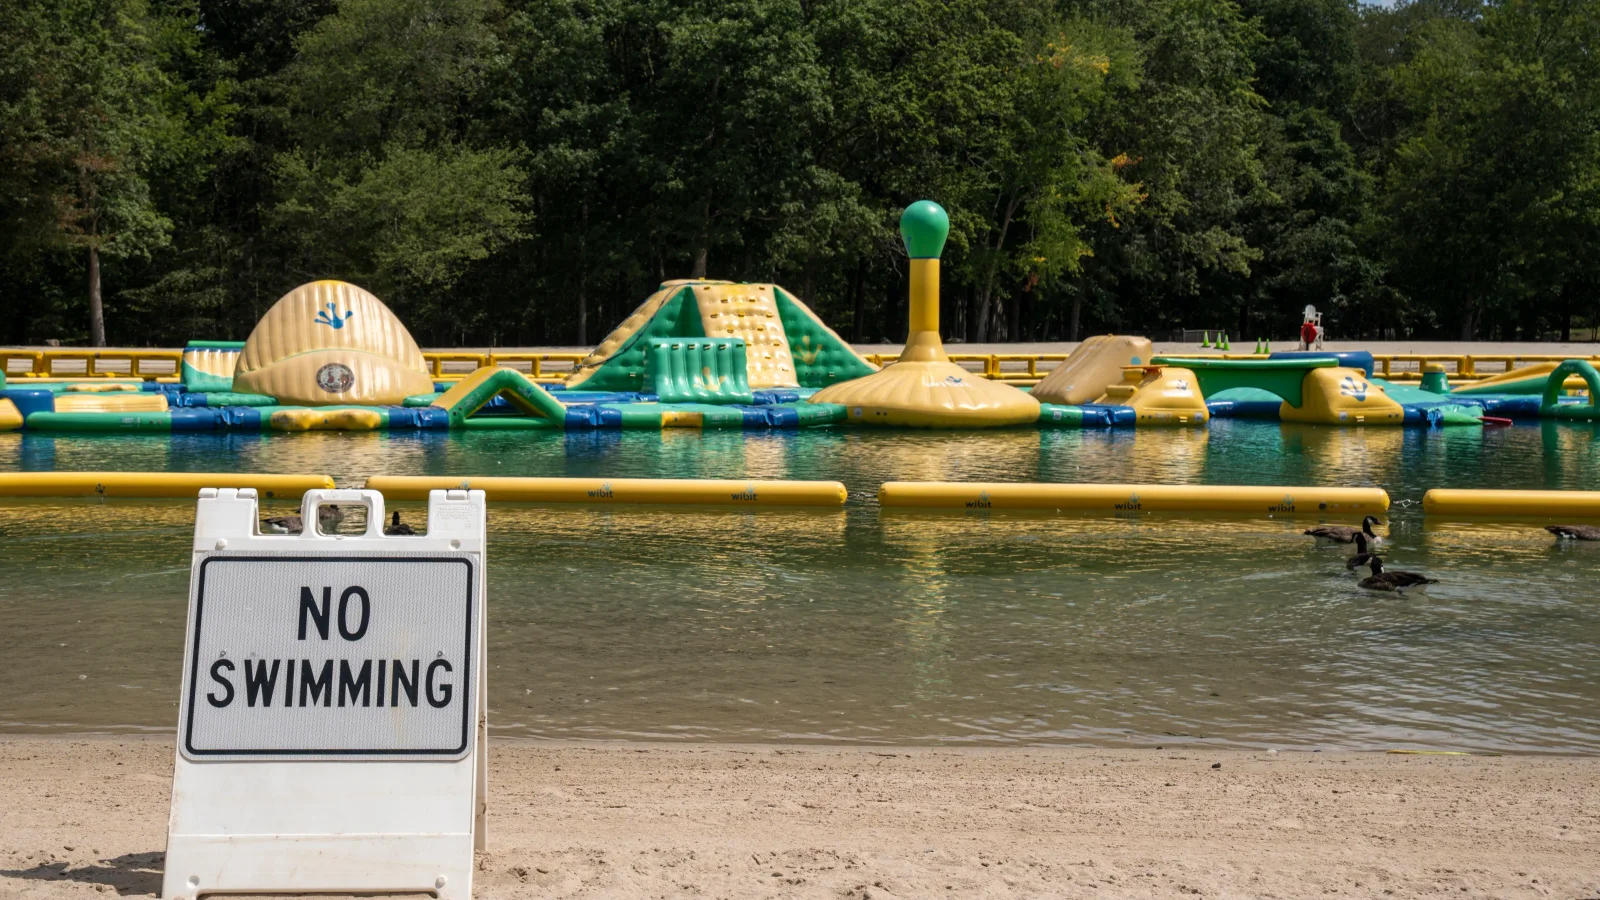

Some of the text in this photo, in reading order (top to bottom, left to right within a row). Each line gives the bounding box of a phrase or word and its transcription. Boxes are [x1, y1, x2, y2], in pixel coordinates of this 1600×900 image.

[587, 488, 614, 498] wibit
[731, 492, 758, 501] wibit
[965, 500, 992, 508] wibit
[1114, 501, 1142, 510] wibit
[1268, 504, 1296, 512] wibit
[297, 586, 371, 641] NO
[206, 658, 453, 709] SWIMMING
